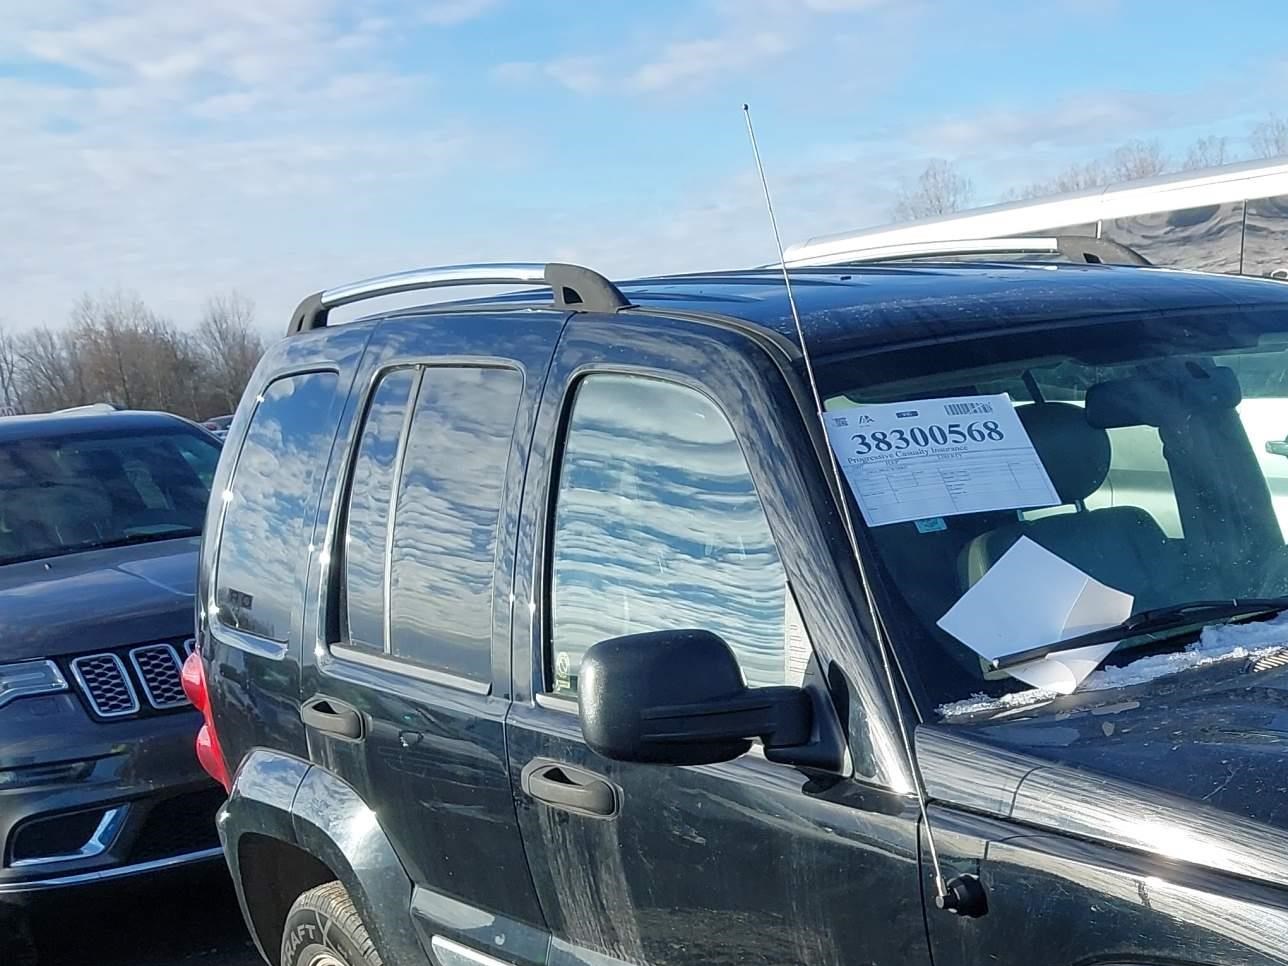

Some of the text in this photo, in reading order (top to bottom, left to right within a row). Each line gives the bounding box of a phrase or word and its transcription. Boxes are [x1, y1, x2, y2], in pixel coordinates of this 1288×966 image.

[850, 420, 1005, 456] 38300568
[847, 443, 969, 465] Progressive Casualty Insurance
